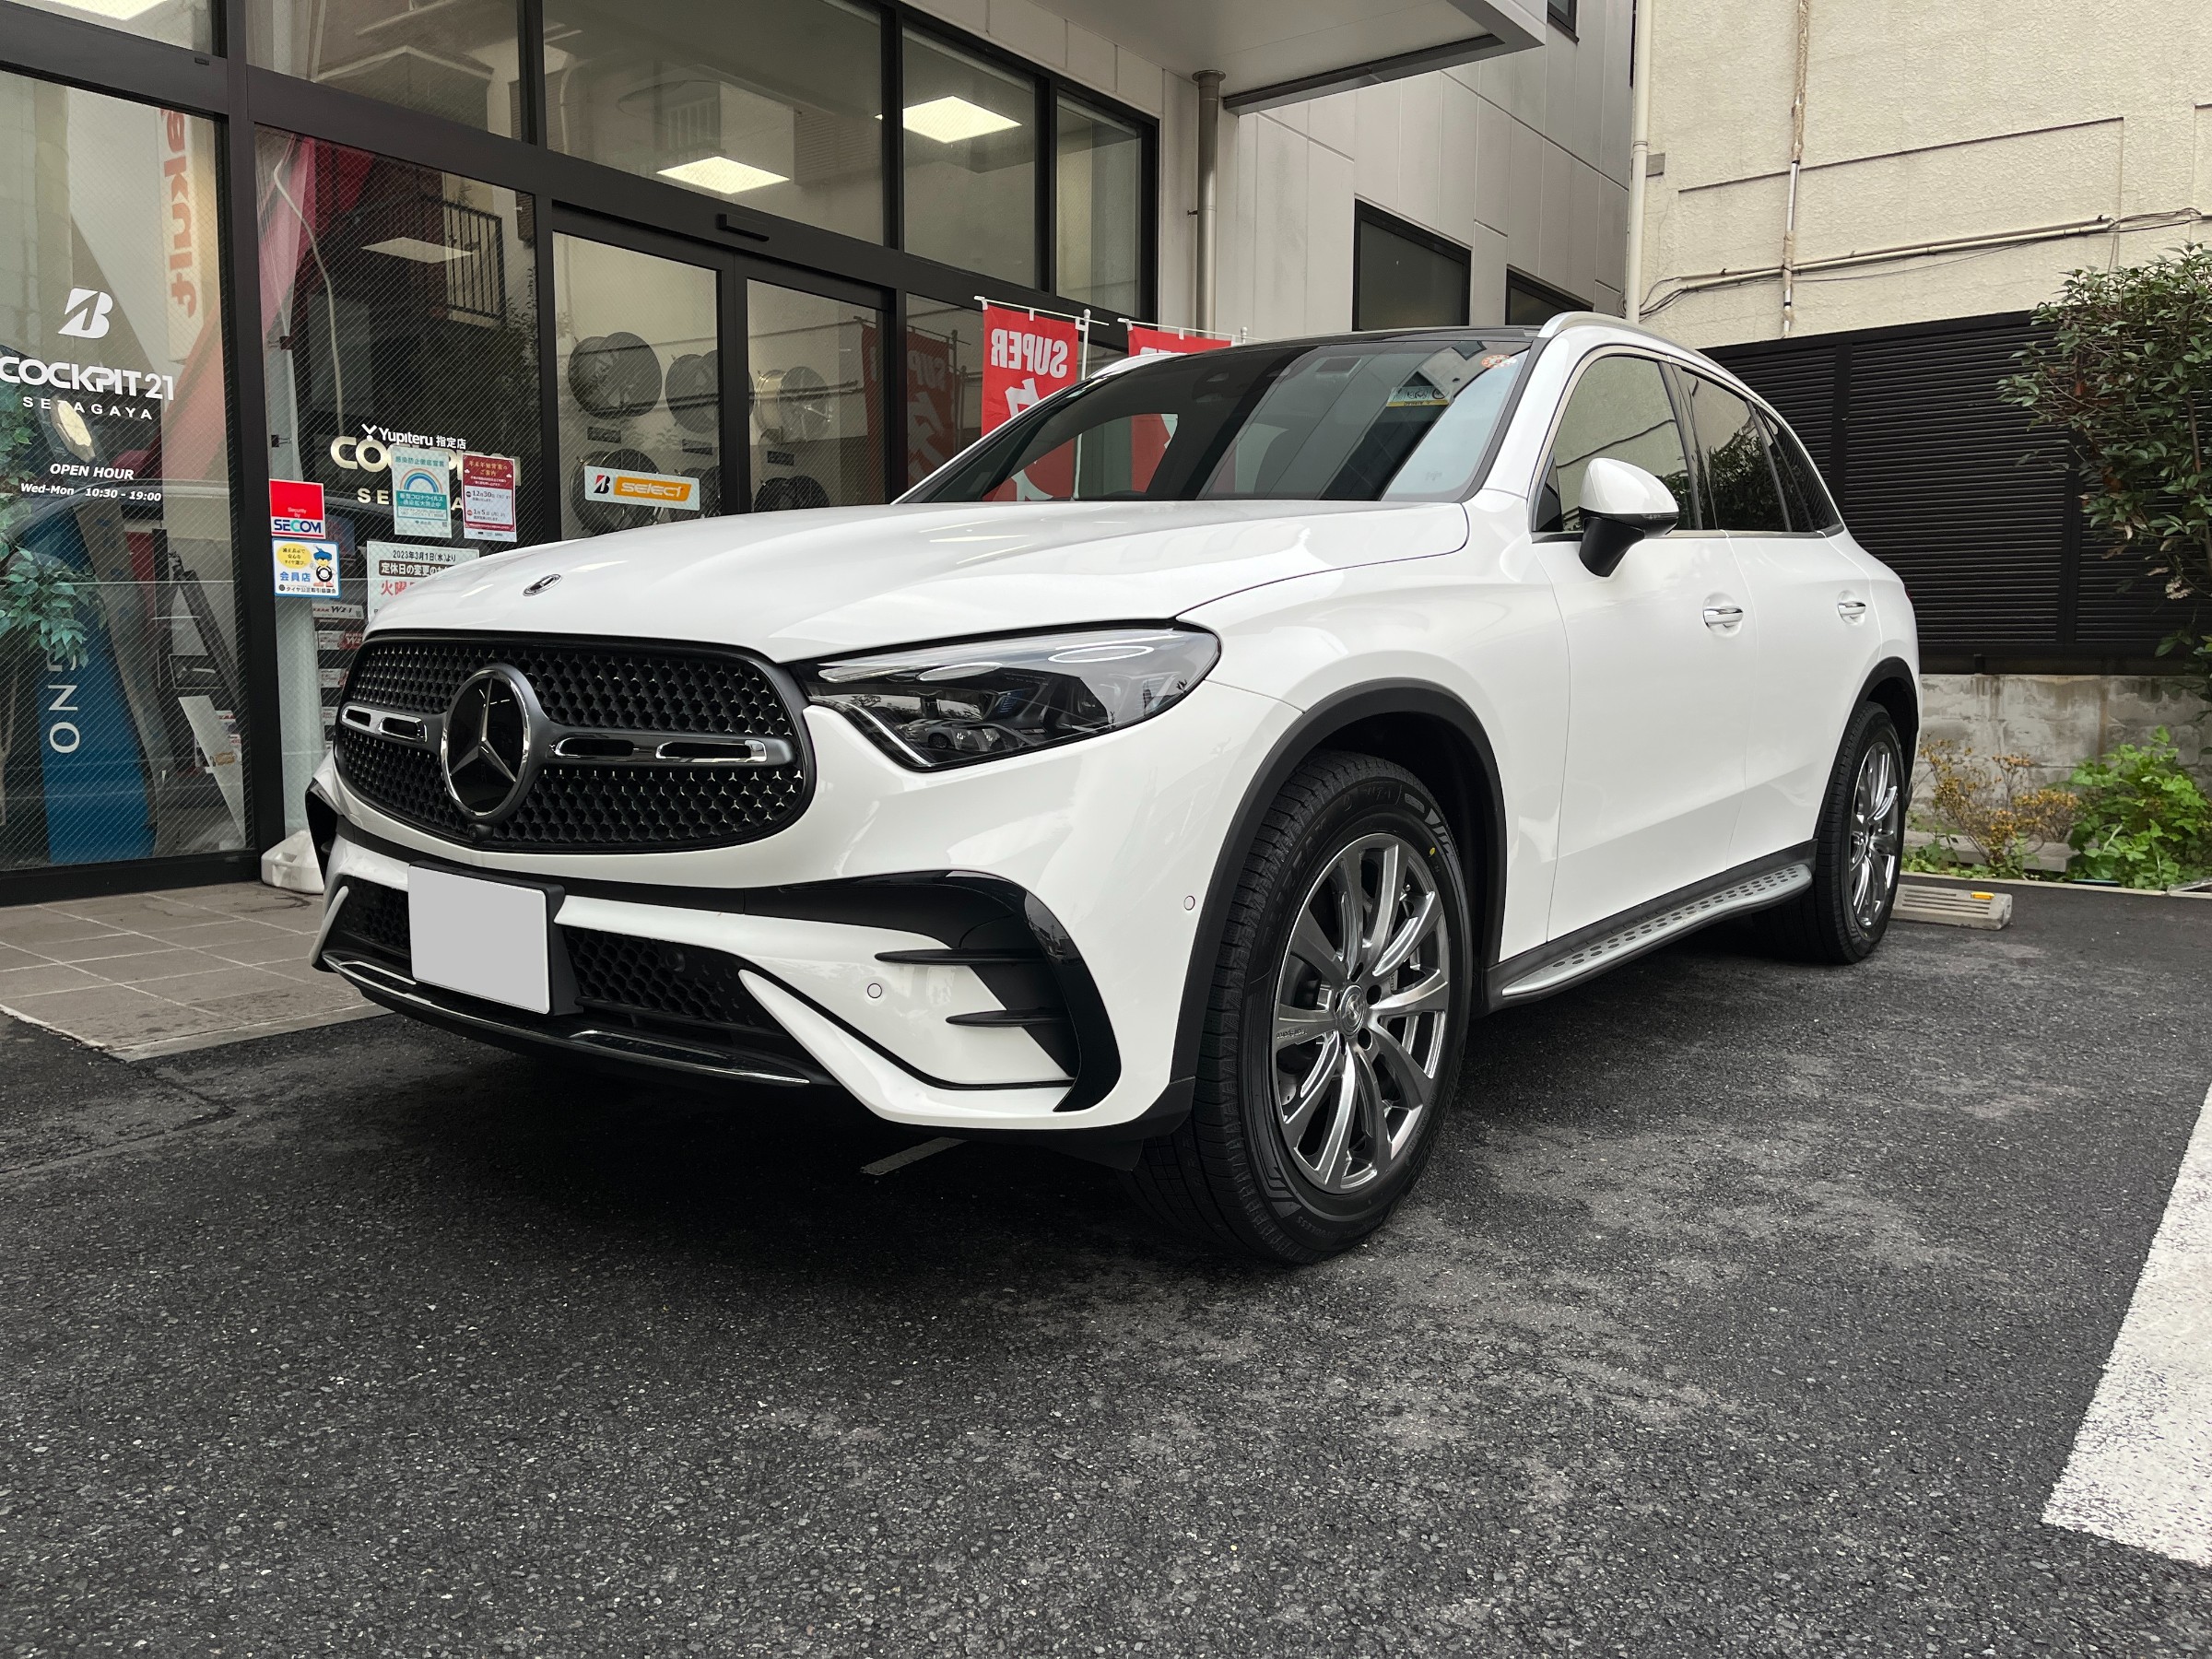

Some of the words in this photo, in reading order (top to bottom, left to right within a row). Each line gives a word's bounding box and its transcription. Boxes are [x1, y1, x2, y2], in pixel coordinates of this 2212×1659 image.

[379, 428, 433, 446] Yupiteru
[436, 436, 466, 450] 指定店
[50, 463, 89, 477] OPEN
[93, 466, 135, 480] HOUR
[20, 482, 75, 496] Wed-Mon
[85, 488, 118, 499] 10:30
[129, 491, 162, 501] 19:00
[620, 481, 683, 498] select
[274, 519, 322, 533] SECOM
[279, 571, 311, 582] 会員店
[381, 562, 449, 576] 定休日の変更の
[381, 580, 415, 596] 火曜
